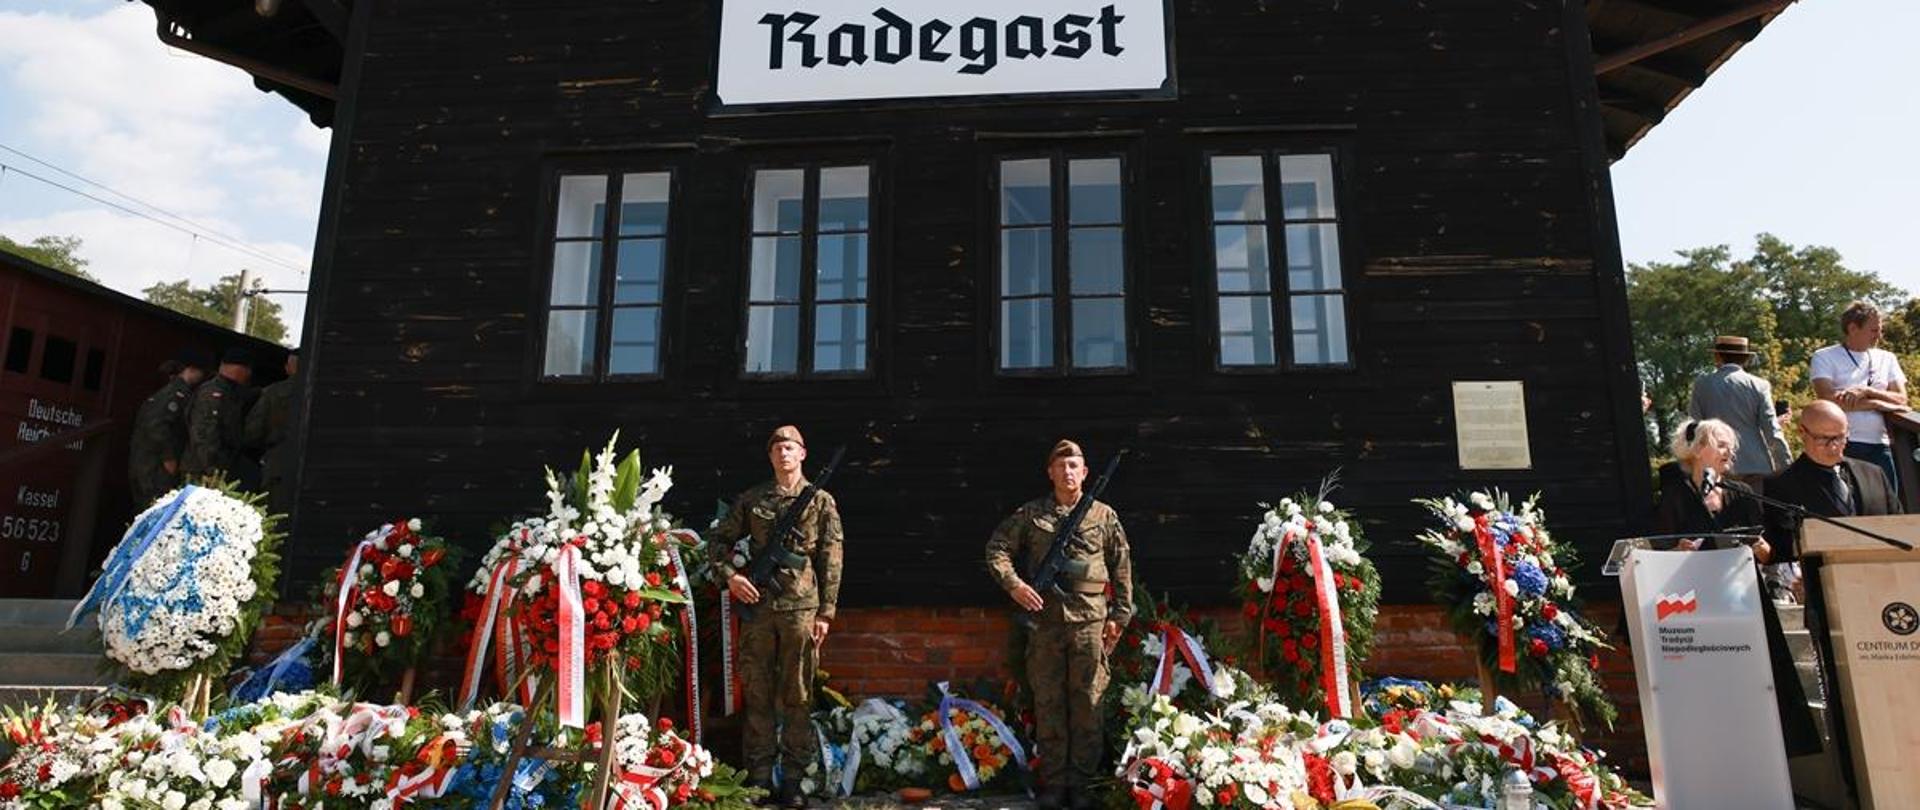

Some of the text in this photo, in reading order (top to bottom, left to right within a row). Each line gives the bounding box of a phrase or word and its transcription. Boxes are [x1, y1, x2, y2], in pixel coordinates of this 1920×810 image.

[757, 4, 1126, 75] Radegast
[27, 398, 83, 427] Deutsche
[17, 485, 60, 509] Kassel
[27, 518, 60, 542] 523
[1857, 641, 1908, 651] CENTRUM
